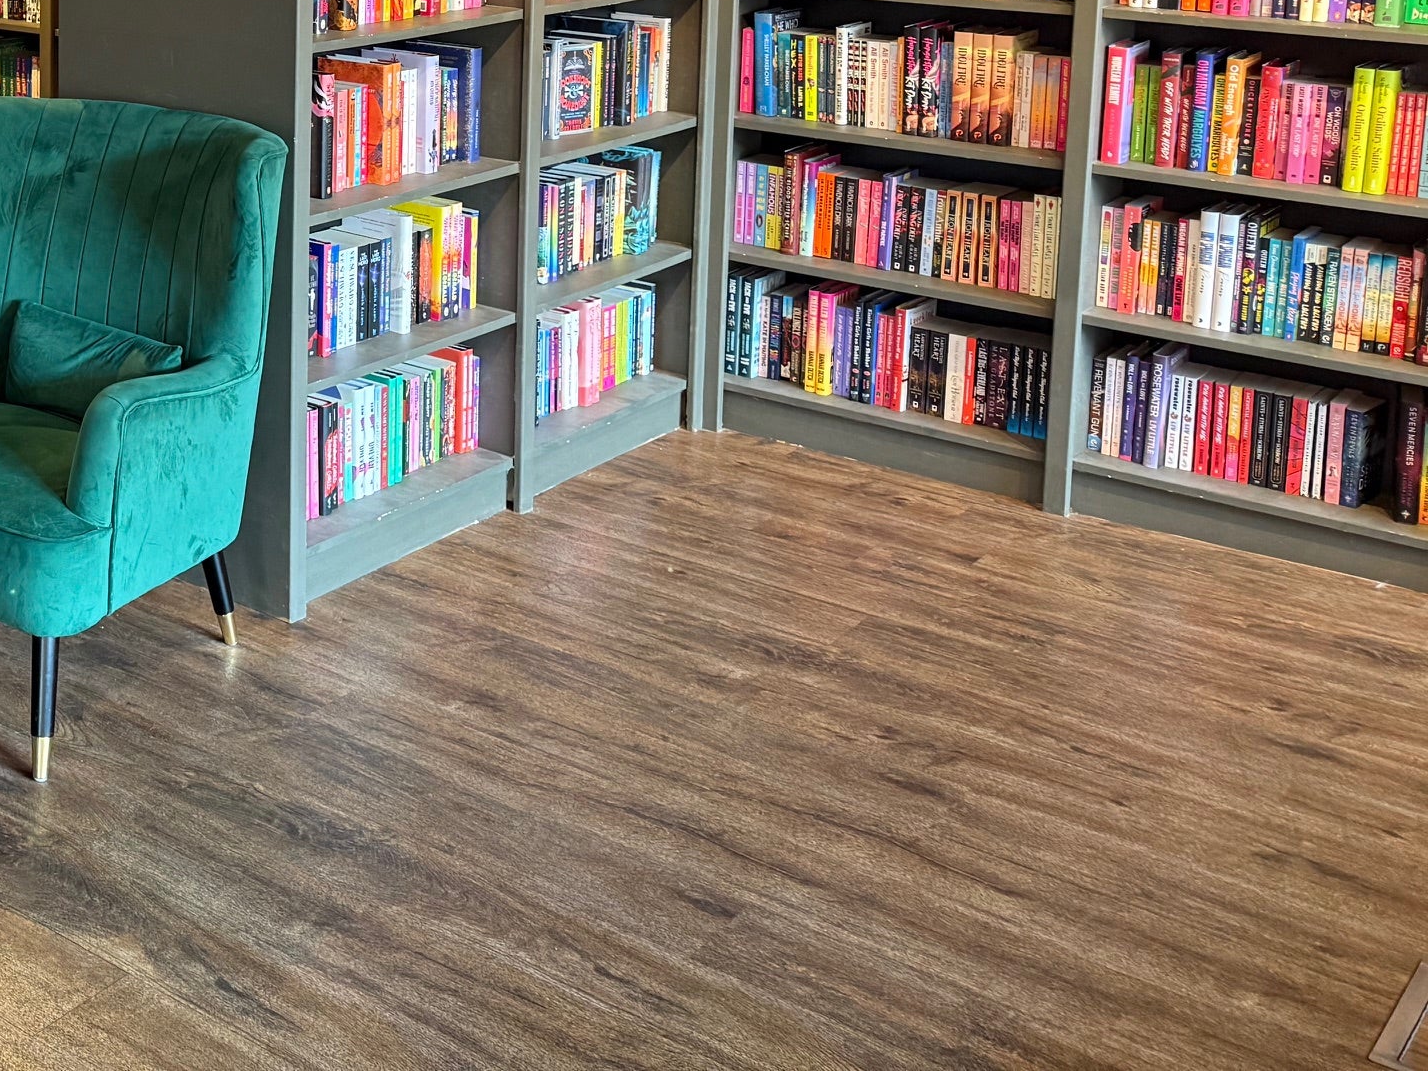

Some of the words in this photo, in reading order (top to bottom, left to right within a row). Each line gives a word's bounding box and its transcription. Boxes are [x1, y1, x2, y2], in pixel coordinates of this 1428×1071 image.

[957, 48, 967, 86] IDOLFIRE
[974, 49, 987, 88] IDOLFIRE
[994, 51, 1007, 90] IDOLFIRE
[1198, 60, 1209, 68] OH
[1229, 65, 1239, 81] Old
[1166, 81, 1174, 94] OFF
[1224, 85, 1238, 116] Enough
[1164, 96, 1173, 115] WITH
[1162, 116, 1172, 135] THEIR
[1191, 110, 1207, 159] MARGOLYES
[1324, 112, 1333, 142] WORLDS
[1350, 104, 1366, 142] Ordinary
[1370, 107, 1387, 144] Ordinary
[1160, 137, 1169, 160] HEADS
[1351, 146, 1361, 171] Saints
[1371, 147, 1382, 173] Saints
[767, 174, 776, 215] INFAMOUS
[937, 193, 946, 213] Iron
[934, 215, 942, 243] Annie
[963, 236, 971, 264] HEART
[982, 238, 991, 265] HEART
[1330, 260, 1338, 285] RAVEN
[1394, 258, 1412, 303] REDSIGHT
[1323, 287, 1336, 331] STRATAGEM
[932, 336, 940, 360] HEART
[1091, 368, 1103, 415] REVENANT
[1150, 363, 1163, 418] ROSEWATER
[1185, 379, 1193, 412] rosewater
[1090, 416, 1100, 436] GUN
[1409, 407, 1417, 431] SEVEN
[1405, 433, 1416, 466] MERCIES
